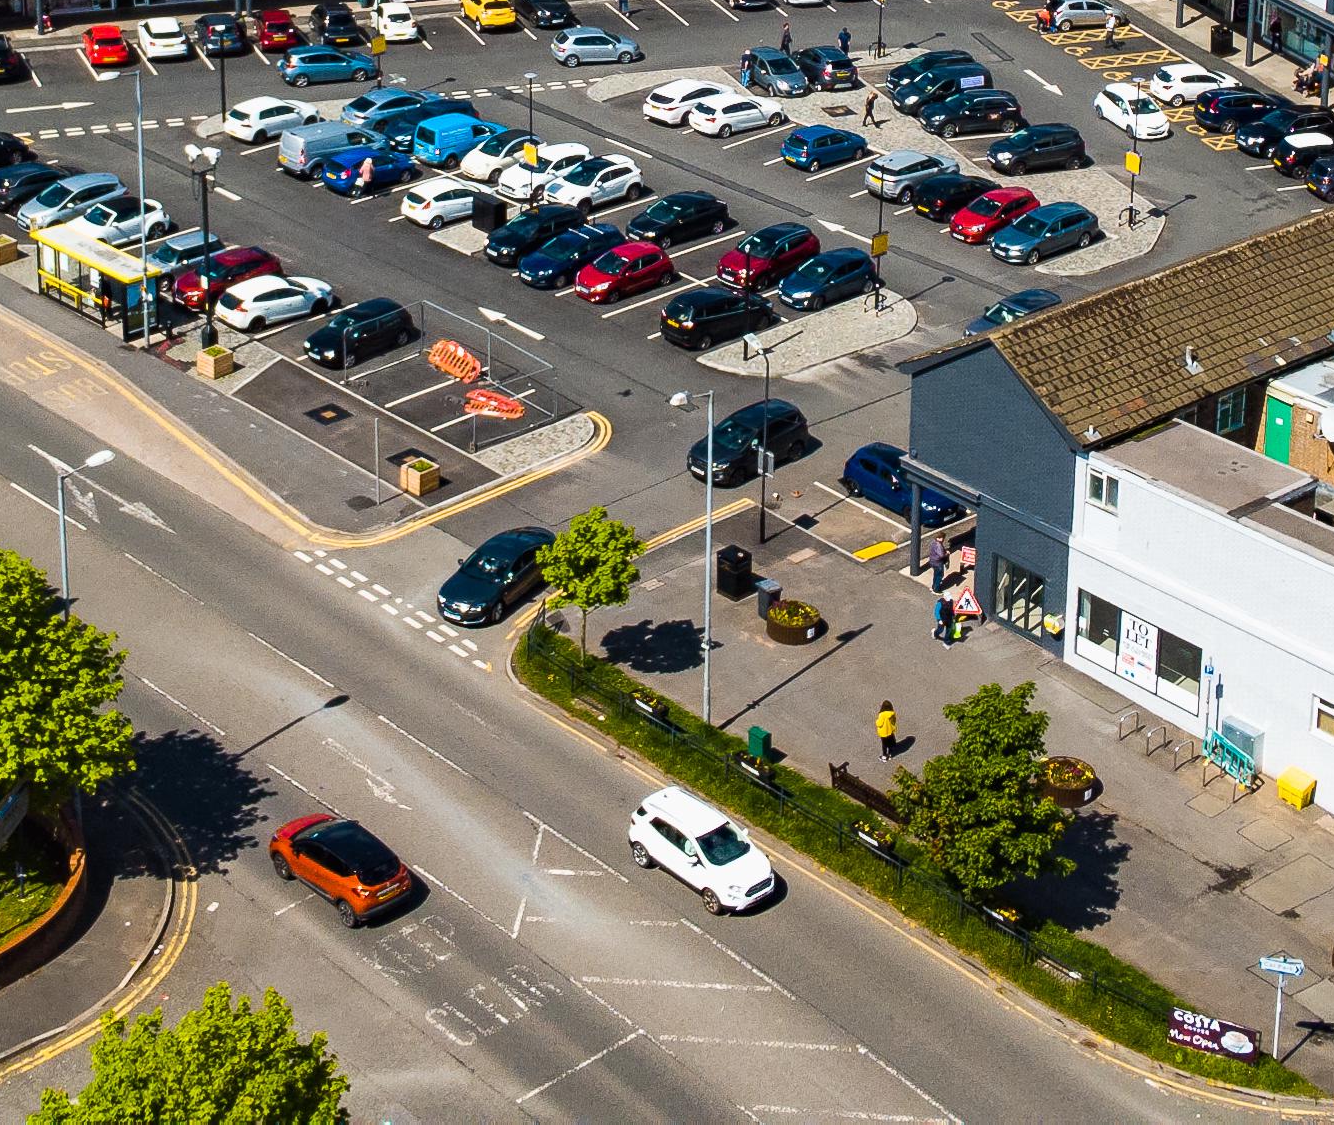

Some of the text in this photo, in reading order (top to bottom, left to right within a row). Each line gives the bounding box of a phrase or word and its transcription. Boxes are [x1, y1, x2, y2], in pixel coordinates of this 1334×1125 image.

[1129, 618, 1149, 636] TO
[1126, 629, 1152, 648] LET
[1174, 1011, 1220, 1032] COSTA
[1193, 1035, 1220, 1051] Open
